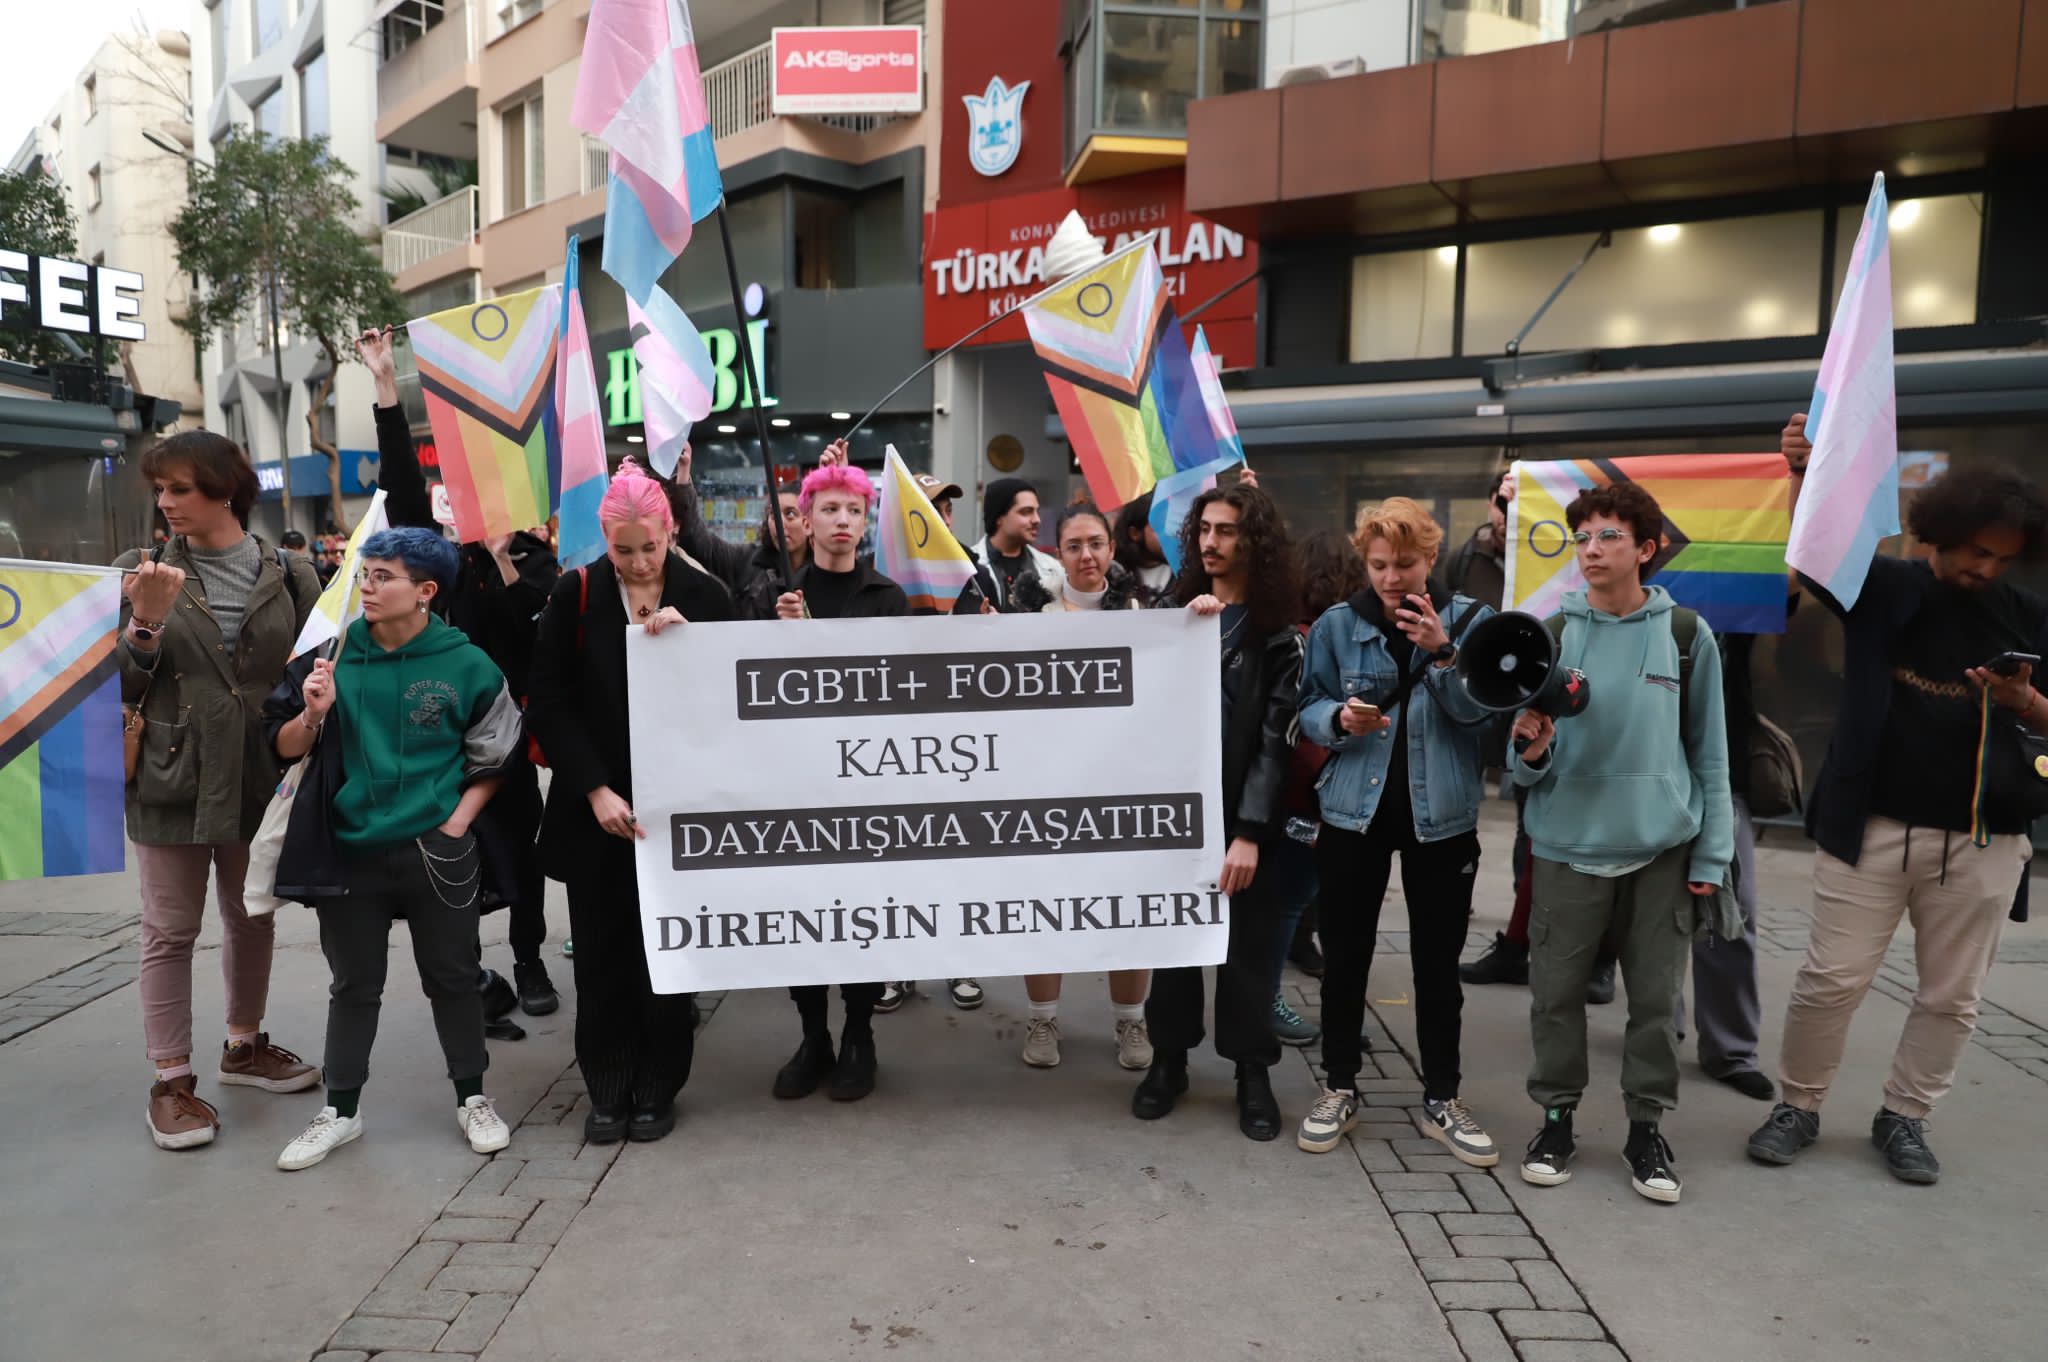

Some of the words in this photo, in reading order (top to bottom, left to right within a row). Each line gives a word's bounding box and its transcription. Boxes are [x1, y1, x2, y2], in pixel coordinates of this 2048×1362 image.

[784, 49, 914, 72] AKSigorta
[1084, 204, 1165, 230] LEDİYESİ
[931, 246, 1046, 295] TÜRKA
[605, 283, 779, 426] HBİ
[745, 658, 927, 706] LGBTİ+
[946, 652, 1123, 699] FOBİYE
[836, 733, 999, 782] KARŞI
[680, 815, 969, 858] DAYANIŞMA
[981, 803, 1195, 850] YAŞATIR!
[657, 897, 940, 950] DİRENİŞİN
[959, 883, 1224, 936] RENKLERİ
